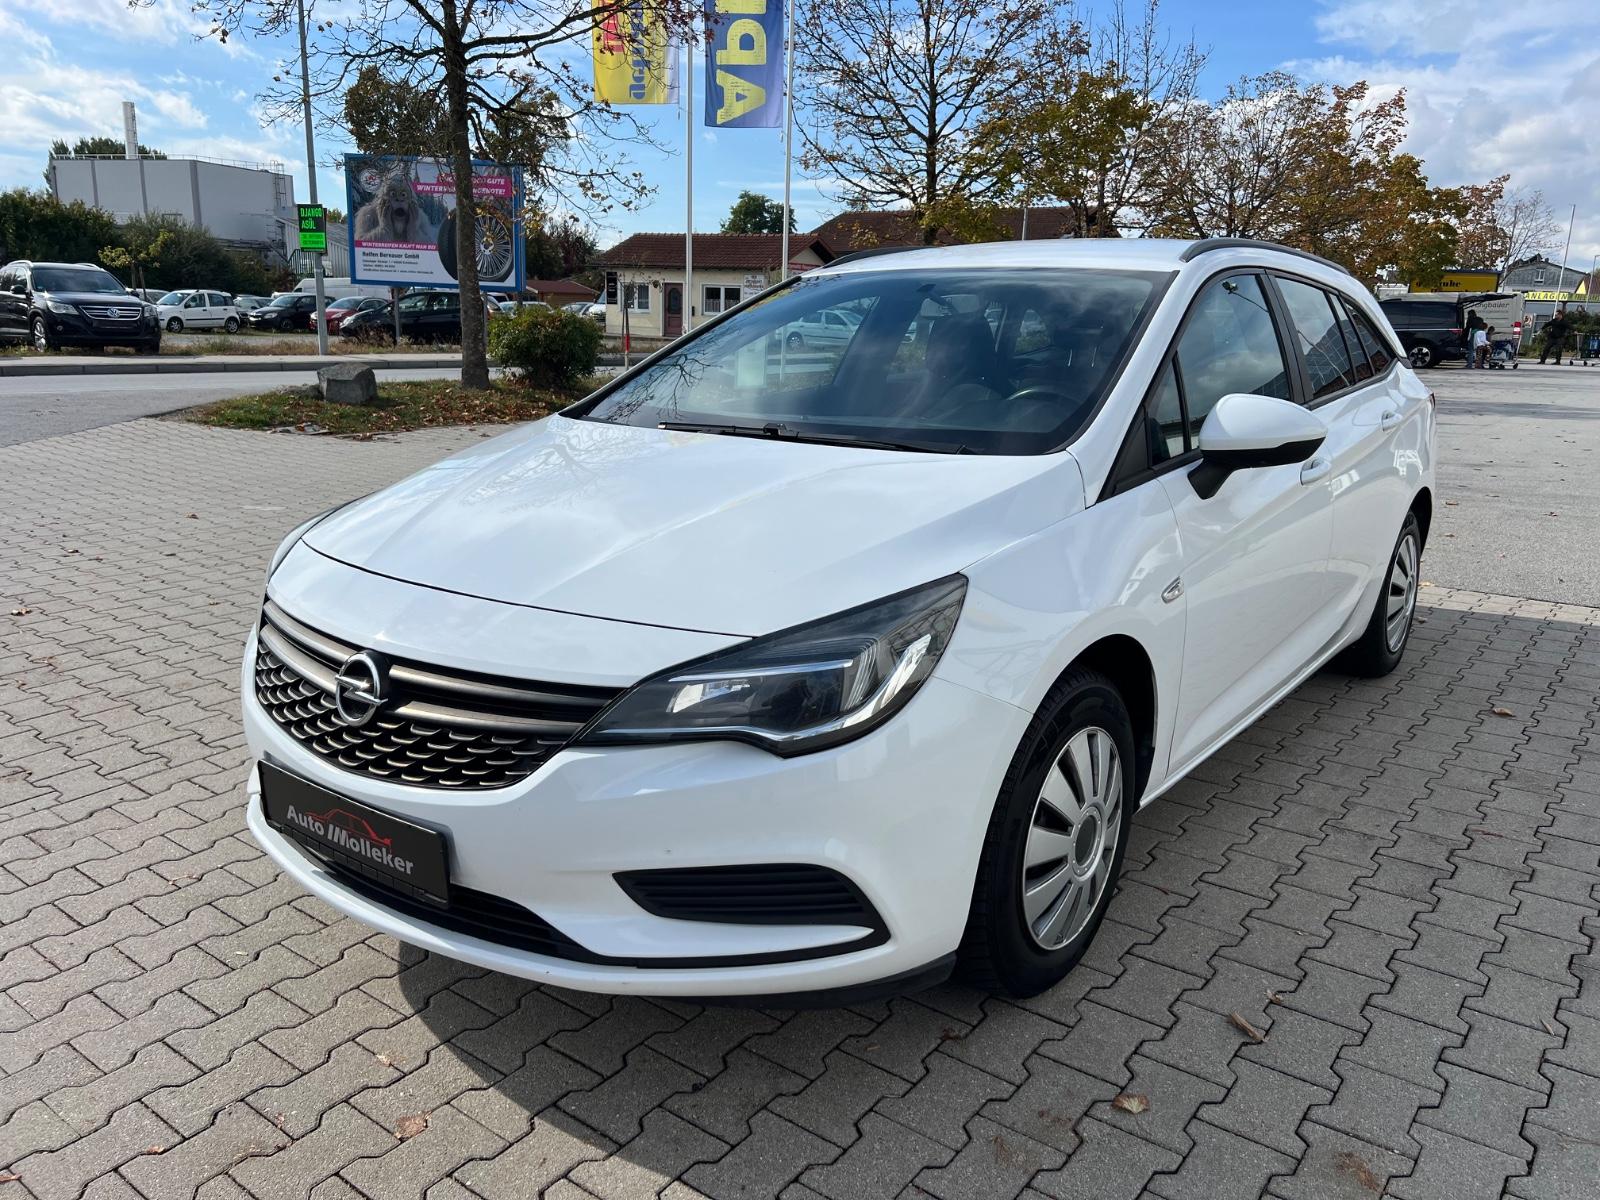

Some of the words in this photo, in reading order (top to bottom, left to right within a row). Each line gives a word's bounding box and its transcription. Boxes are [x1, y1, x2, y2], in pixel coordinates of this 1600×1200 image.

[300, 207, 323, 217] DJANGO
[301, 218, 316, 229] ASÜL
[286, 805, 325, 836] Auto
[327, 823, 414, 875] Molleker
